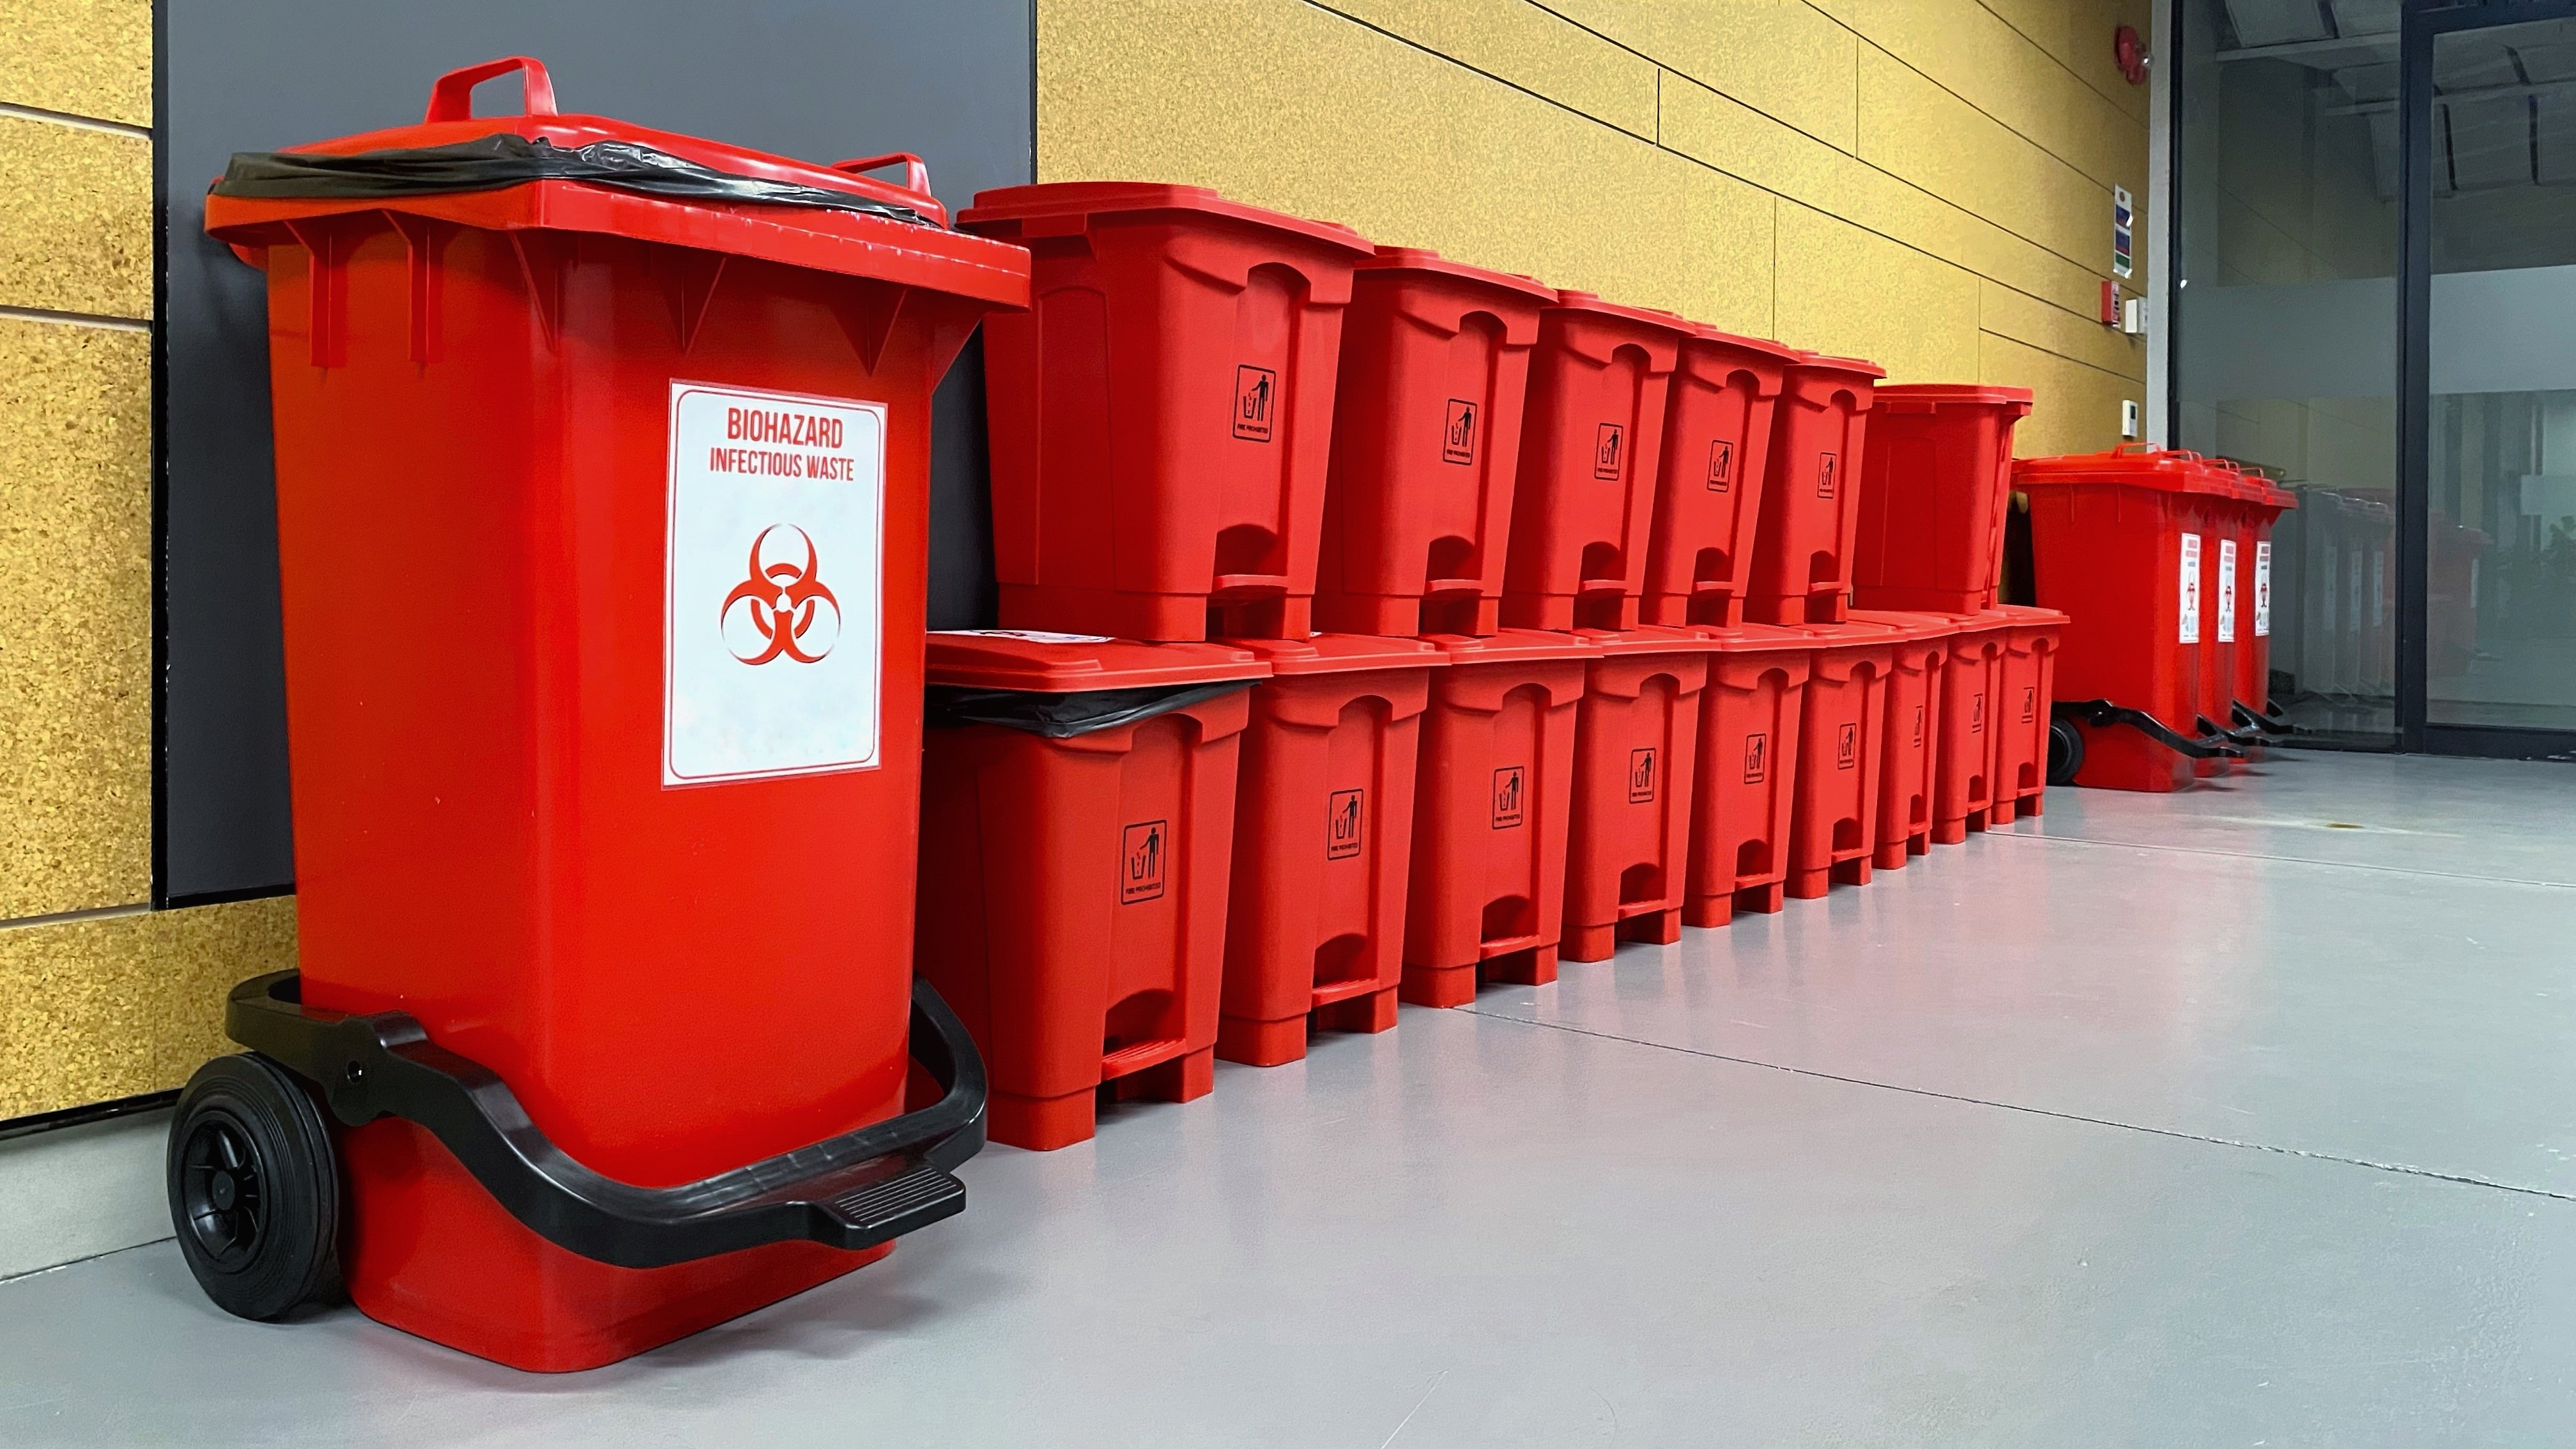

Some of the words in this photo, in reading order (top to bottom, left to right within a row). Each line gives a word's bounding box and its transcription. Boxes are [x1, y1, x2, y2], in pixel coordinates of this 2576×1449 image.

[728, 407, 843, 448] BIOHAZARD
[709, 447, 802, 477] INFECTIOUS
[806, 454, 854, 481] WASTE
